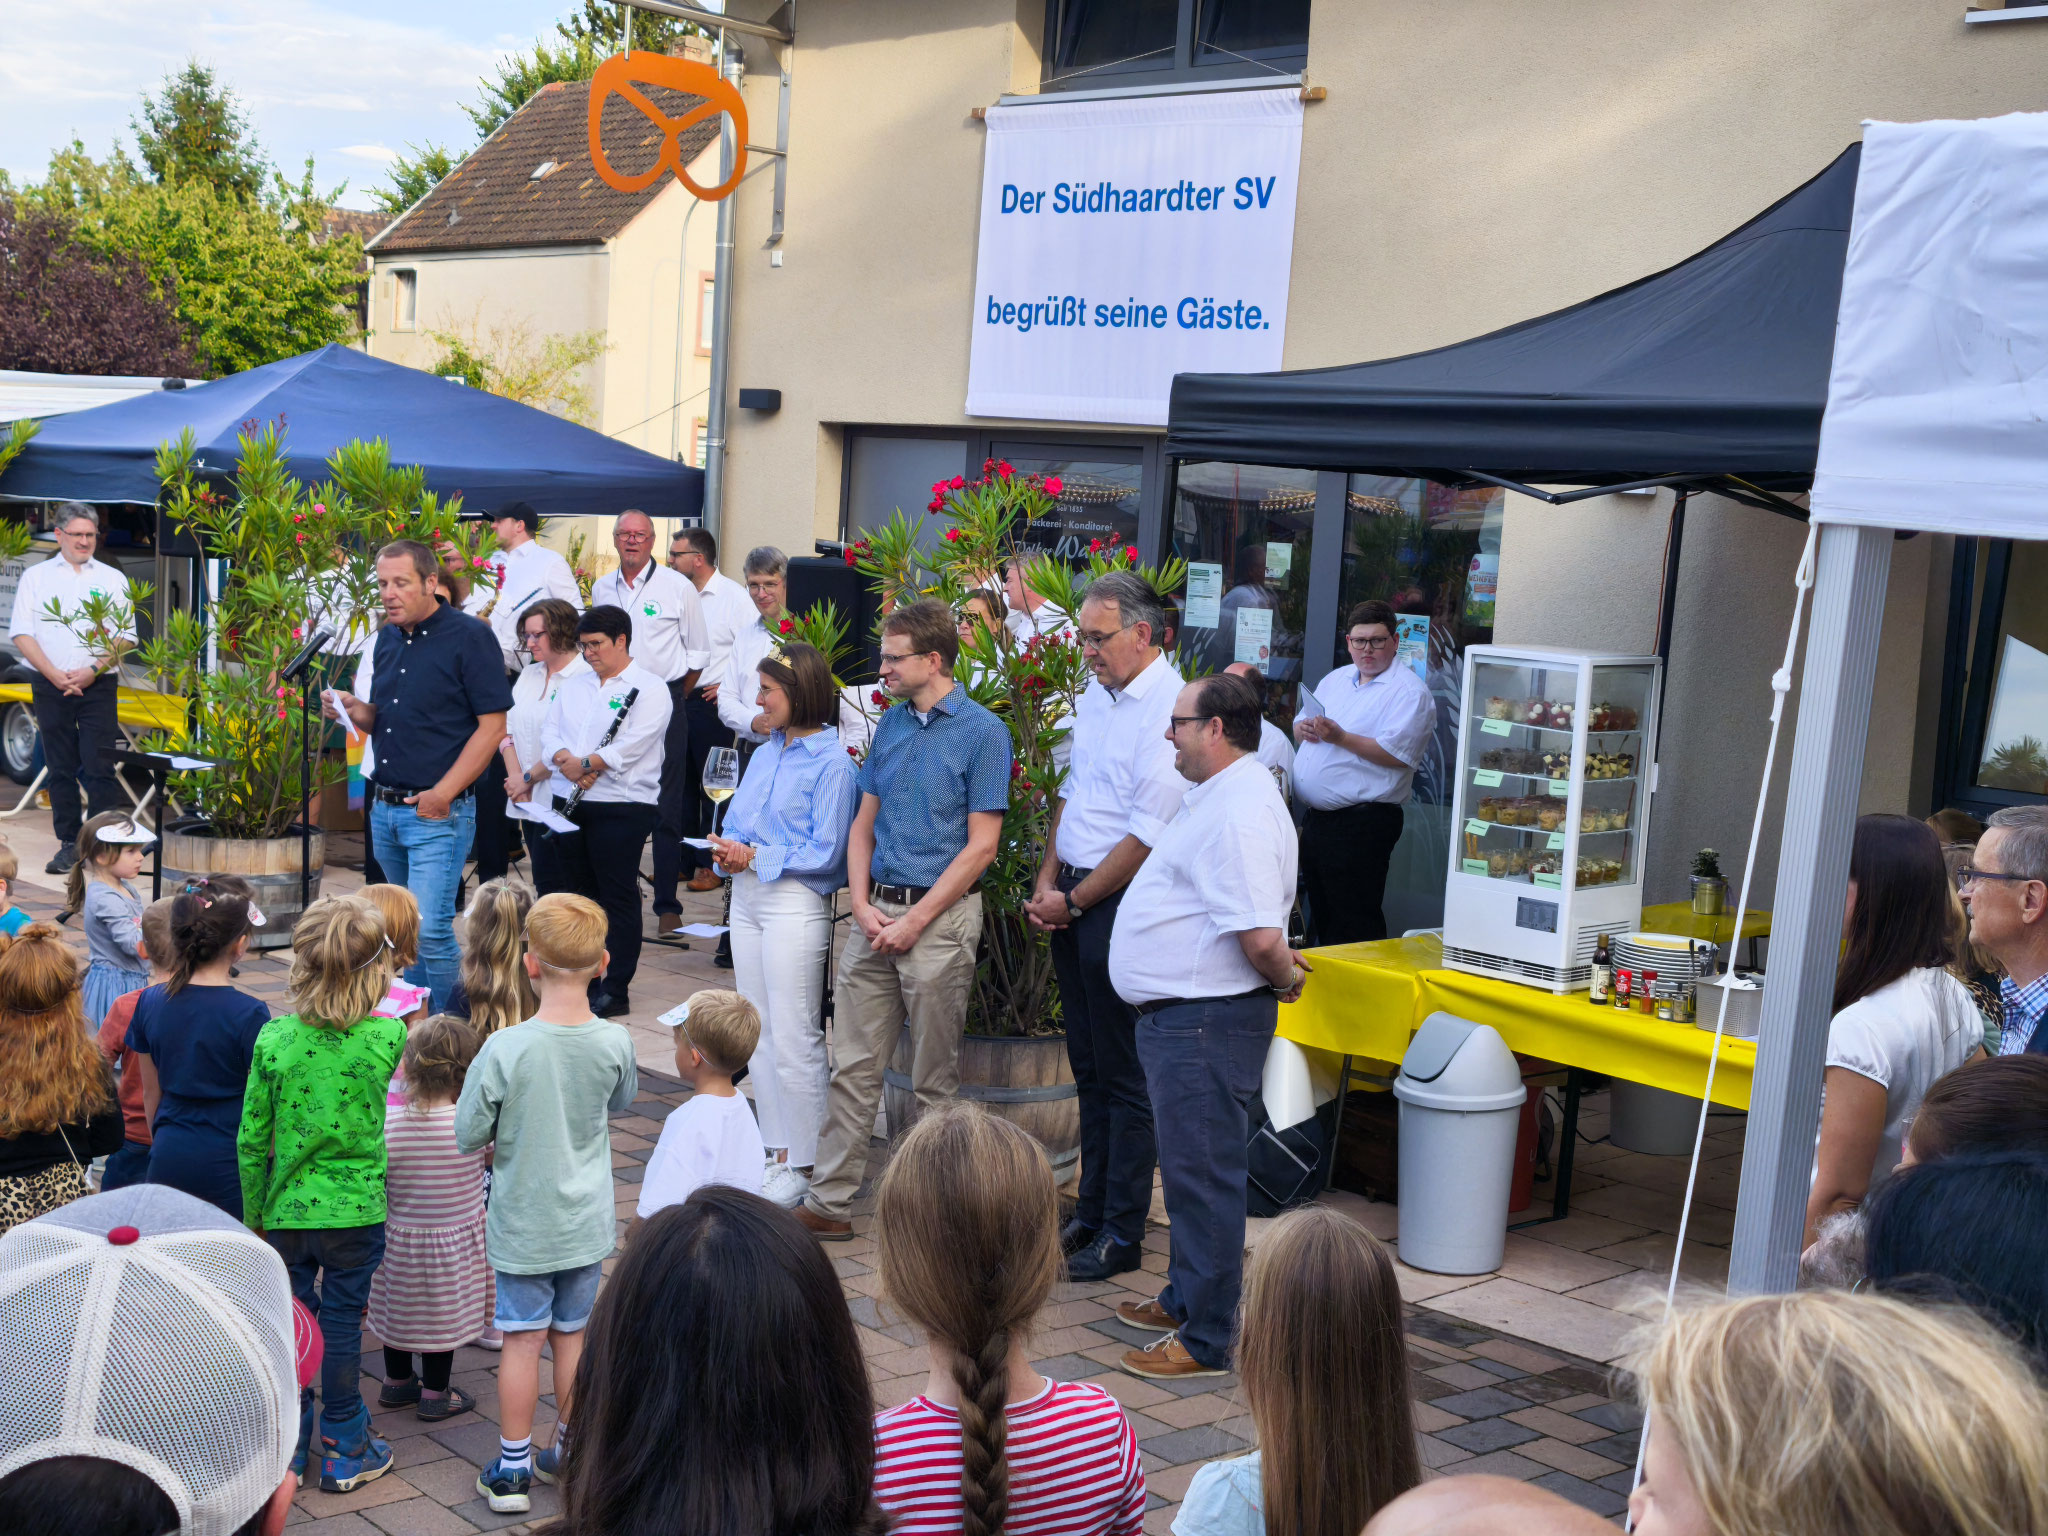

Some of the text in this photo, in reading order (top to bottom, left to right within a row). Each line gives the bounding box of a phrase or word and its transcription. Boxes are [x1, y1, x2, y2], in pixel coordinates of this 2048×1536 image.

[1001, 176, 1276, 214] Der Südhaardter SV
[986, 295, 1270, 333] begrüßt seine Gäste.
[1068, 519, 1113, 531] Konditorei
